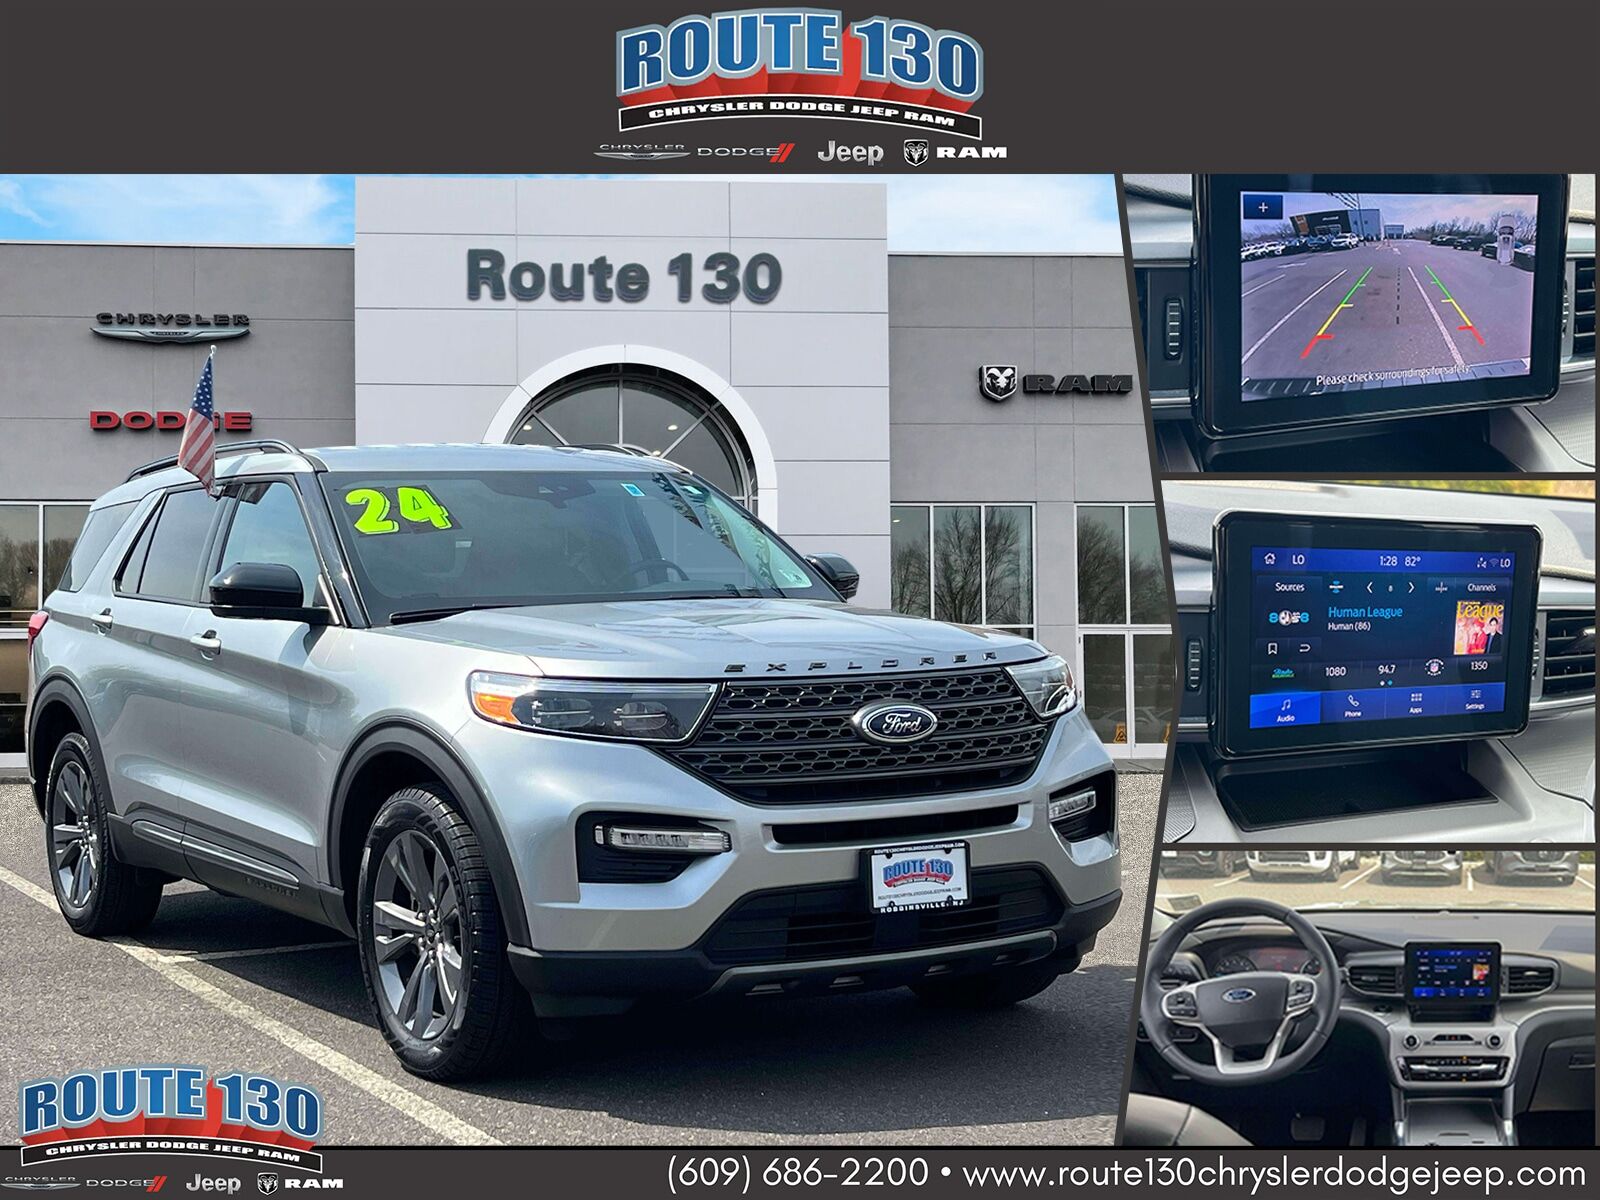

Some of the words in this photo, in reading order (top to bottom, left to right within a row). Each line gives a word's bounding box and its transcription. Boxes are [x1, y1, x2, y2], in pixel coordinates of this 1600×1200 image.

[467, 248, 651, 302] Route
[668, 251, 783, 304] 130
[96, 312, 250, 326] CHRYSLER
[1316, 374, 1347, 386] Please
[1348, 371, 1376, 382] check
[1376, 367, 1431, 379] surroundings
[1023, 374, 1134, 394] RAM
[90, 410, 252, 431] DODE
[345, 486, 454, 535] 24
[1292, 554, 1305, 565] LO
[1379, 555, 1398, 567] 1:28
[1499, 558, 1511, 568] LO
[1275, 582, 1305, 593] Sources
[1467, 583, 1497, 593] Channels
[1328, 606, 1366, 618] Human
[1367, 606, 1403, 619] League
[1328, 621, 1354, 631] Human
[1354, 621, 1371, 632] (86)
[723, 651, 998, 673] EXPLORER
[1471, 660, 1489, 671] 1350
[1325, 665, 1347, 677] 1080
[1377, 664, 1396, 675] 94.7
[1344, 709, 1362, 719] Phone
[1409, 706, 1423, 715] Apps
[881, 712, 923, 735] Ford
[1276, 714, 1295, 724] Audio
[883, 859, 927, 880] ROUTE
[929, 858, 953, 877] 130
